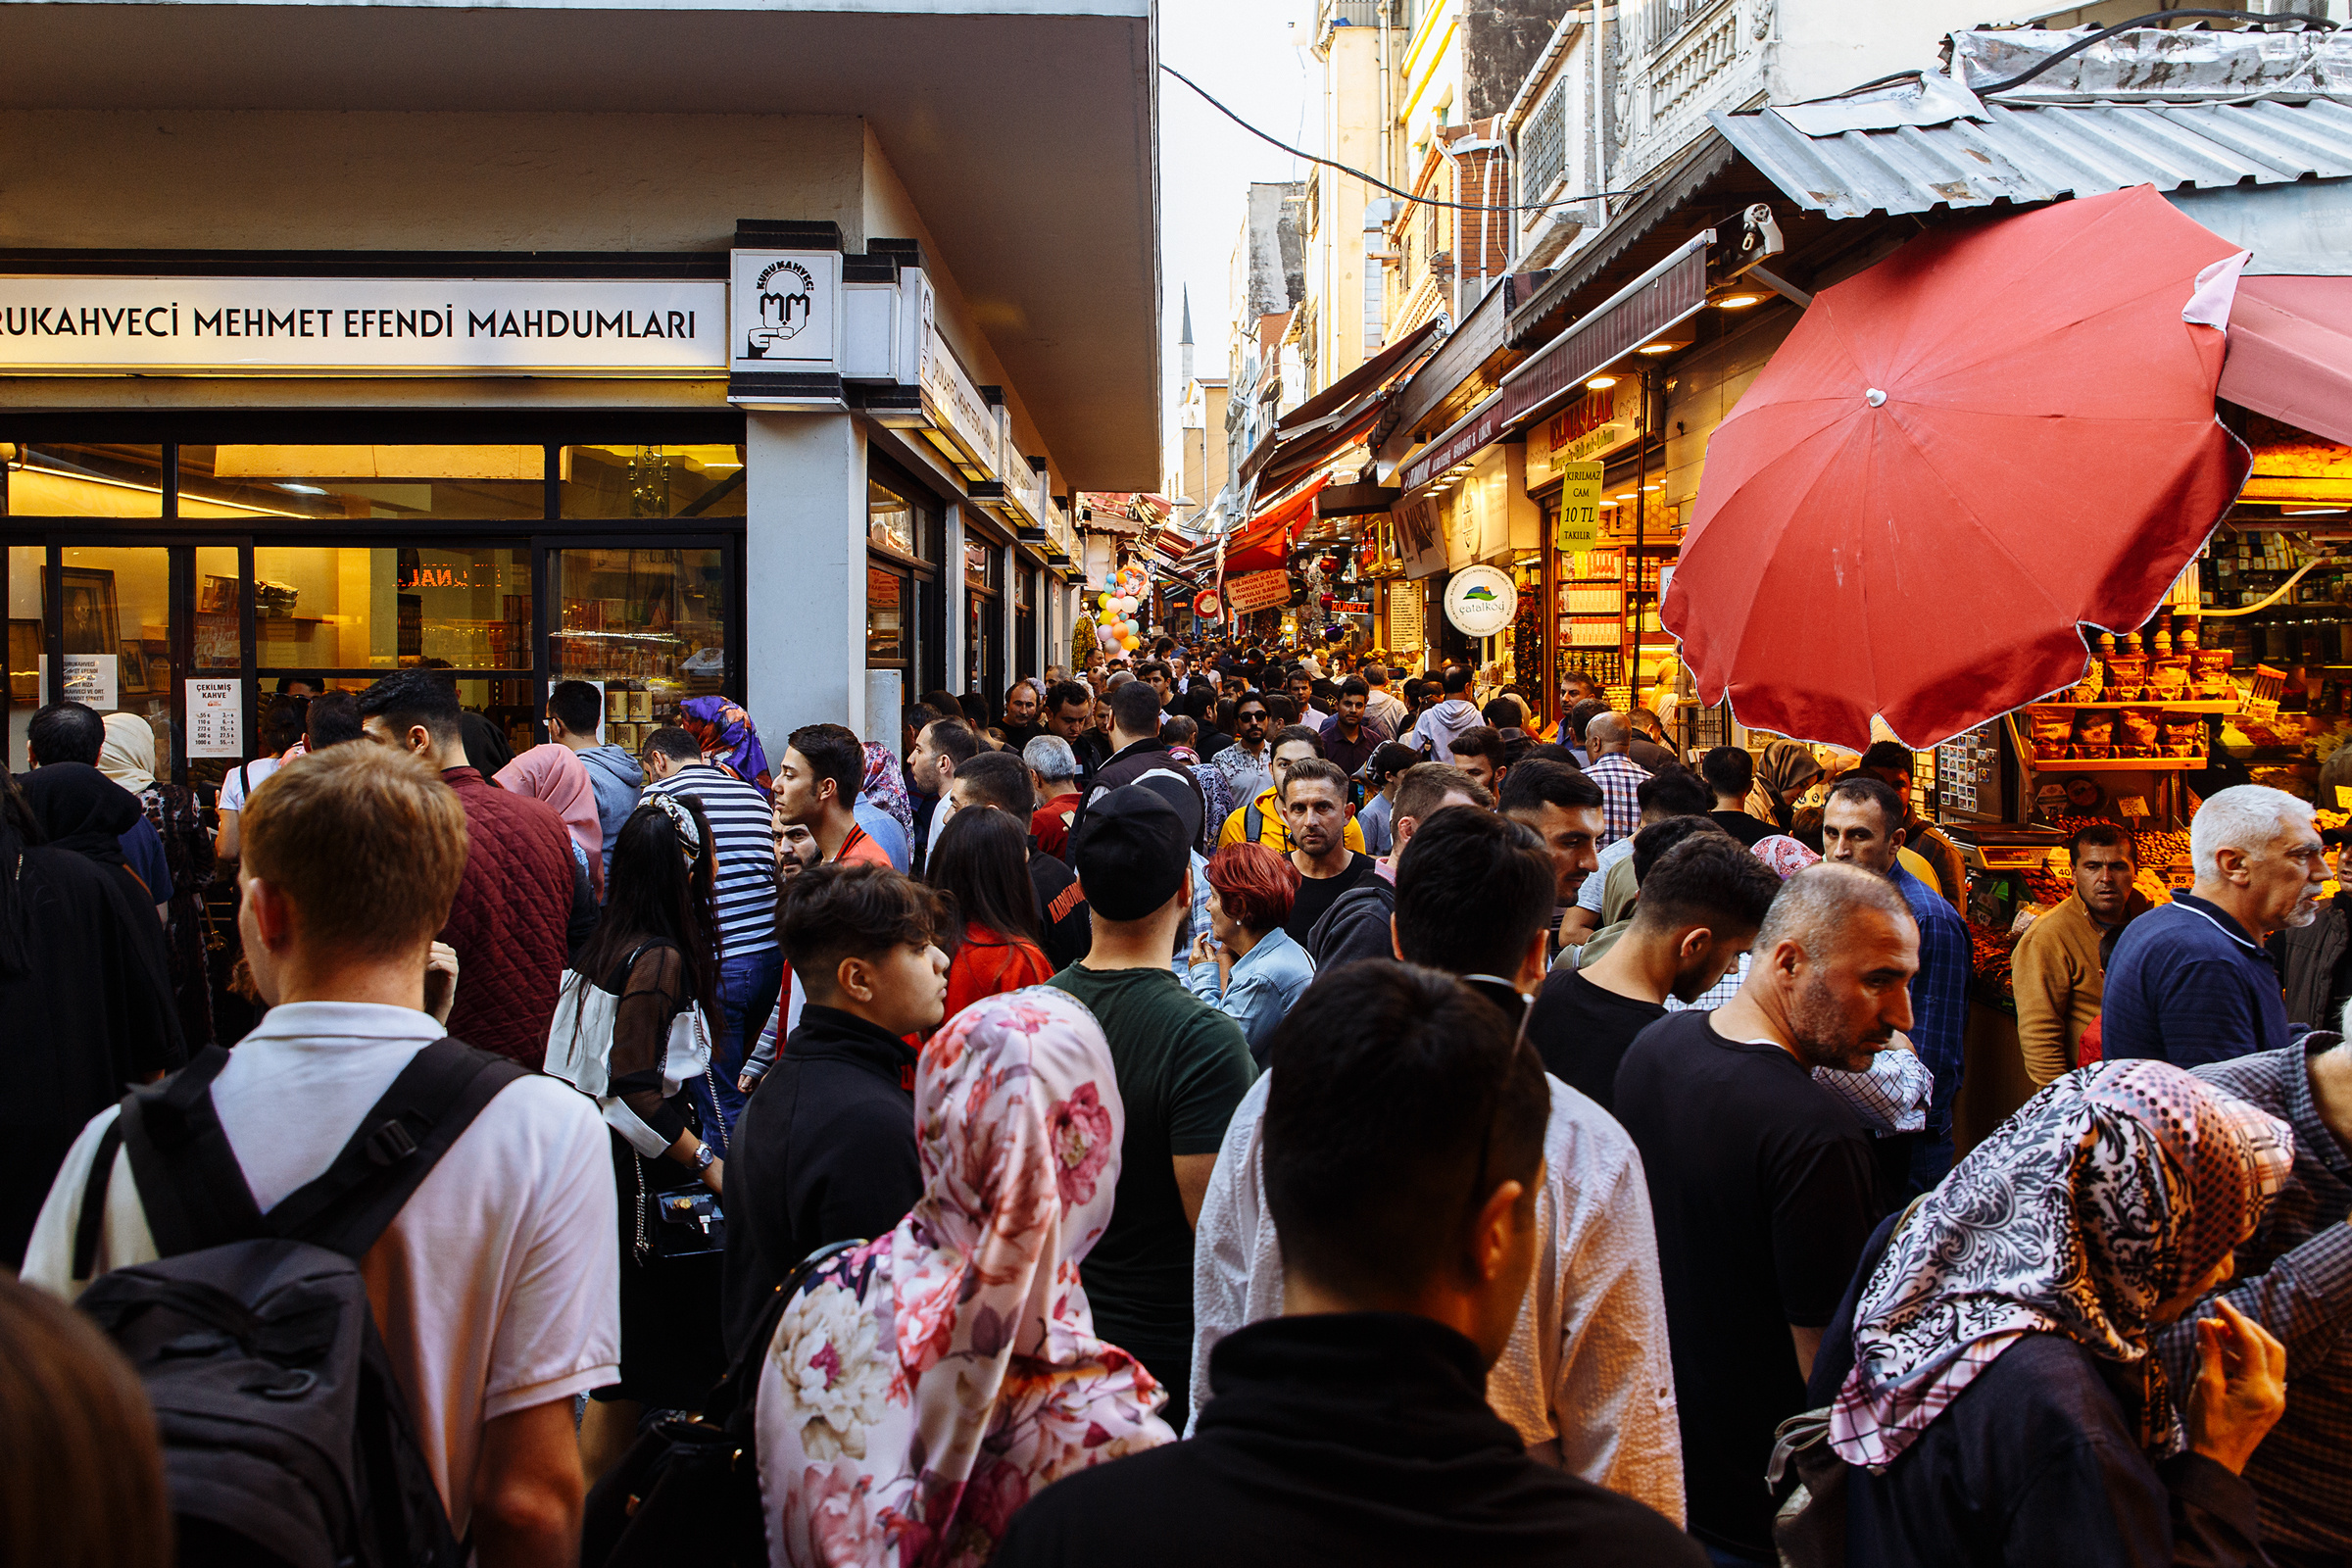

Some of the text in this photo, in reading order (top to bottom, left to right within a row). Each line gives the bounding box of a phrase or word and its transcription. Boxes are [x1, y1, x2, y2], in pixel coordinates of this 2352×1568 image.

[194, 308, 333, 338] MEHMET
[344, 304, 453, 338] EFENDİ
[468, 309, 695, 339] MAHDUMLARI
[1566, 471, 1601, 480] KIRILMAZ
[1573, 488, 1590, 497] CAM
[1564, 507, 1594, 522] 10 TL
[1564, 531, 1591, 540] TAKILIR
[1230, 571, 1281, 589] SİLİKON KALIP
[1232, 583, 1286, 602] KOKULU SABUN
[1236, 582, 1264, 594] KOKULU
[1245, 593, 1276, 605] PASTANE
[1331, 600, 1369, 613] KÜNEFE
[196, 683, 232, 692] ÇEKİLMİŞ
